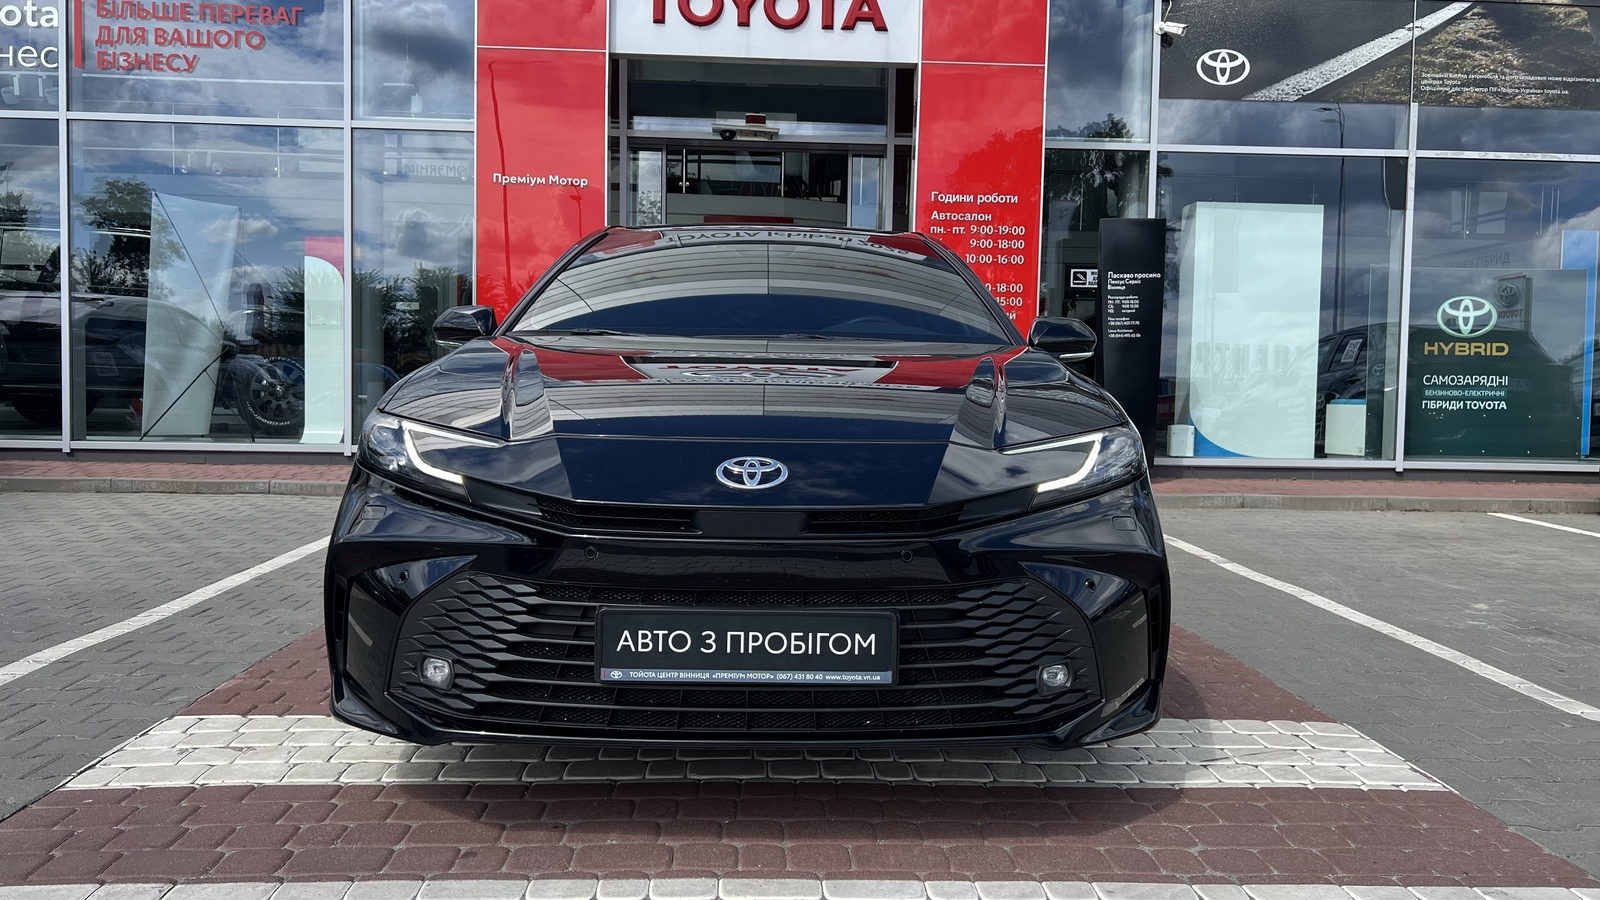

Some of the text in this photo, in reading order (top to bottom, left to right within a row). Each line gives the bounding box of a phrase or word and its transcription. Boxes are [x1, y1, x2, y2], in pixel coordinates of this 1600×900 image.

[0, 0, 58, 28] ota
[96, 0, 304, 25] БІЛЬШЕ ПЕРЕВАГ
[95, 25, 266, 50] ДЛЯ ВАШОГО
[96, 50, 198, 72] БІЗНЕСУ
[493, 173, 589, 188] Преміум Мотор
[931, 191, 1019, 205] Години роботи
[931, 210, 992, 221] Автосалон
[1424, 341, 1509, 356] HYBRID
[1423, 374, 1508, 388] САМОЗАРЯДНІ
[1425, 389, 1505, 397] БЕНЗИНОВО-ЕЛЕКТРИЧНІ
[1422, 400, 1507, 411] ГІБРИДИ TOYOTA
[616, 629, 876, 655] АВТО З ПРОБІГОМ
[629, 670, 656, 678] ТОЙОТА
[657, 671, 679, 679] ЦЕНТР
[680, 672, 710, 680] ВІННИЦЯ
[776, 673, 793, 681] (067)
[825, 674, 881, 682] www.toyota.vn.ua
